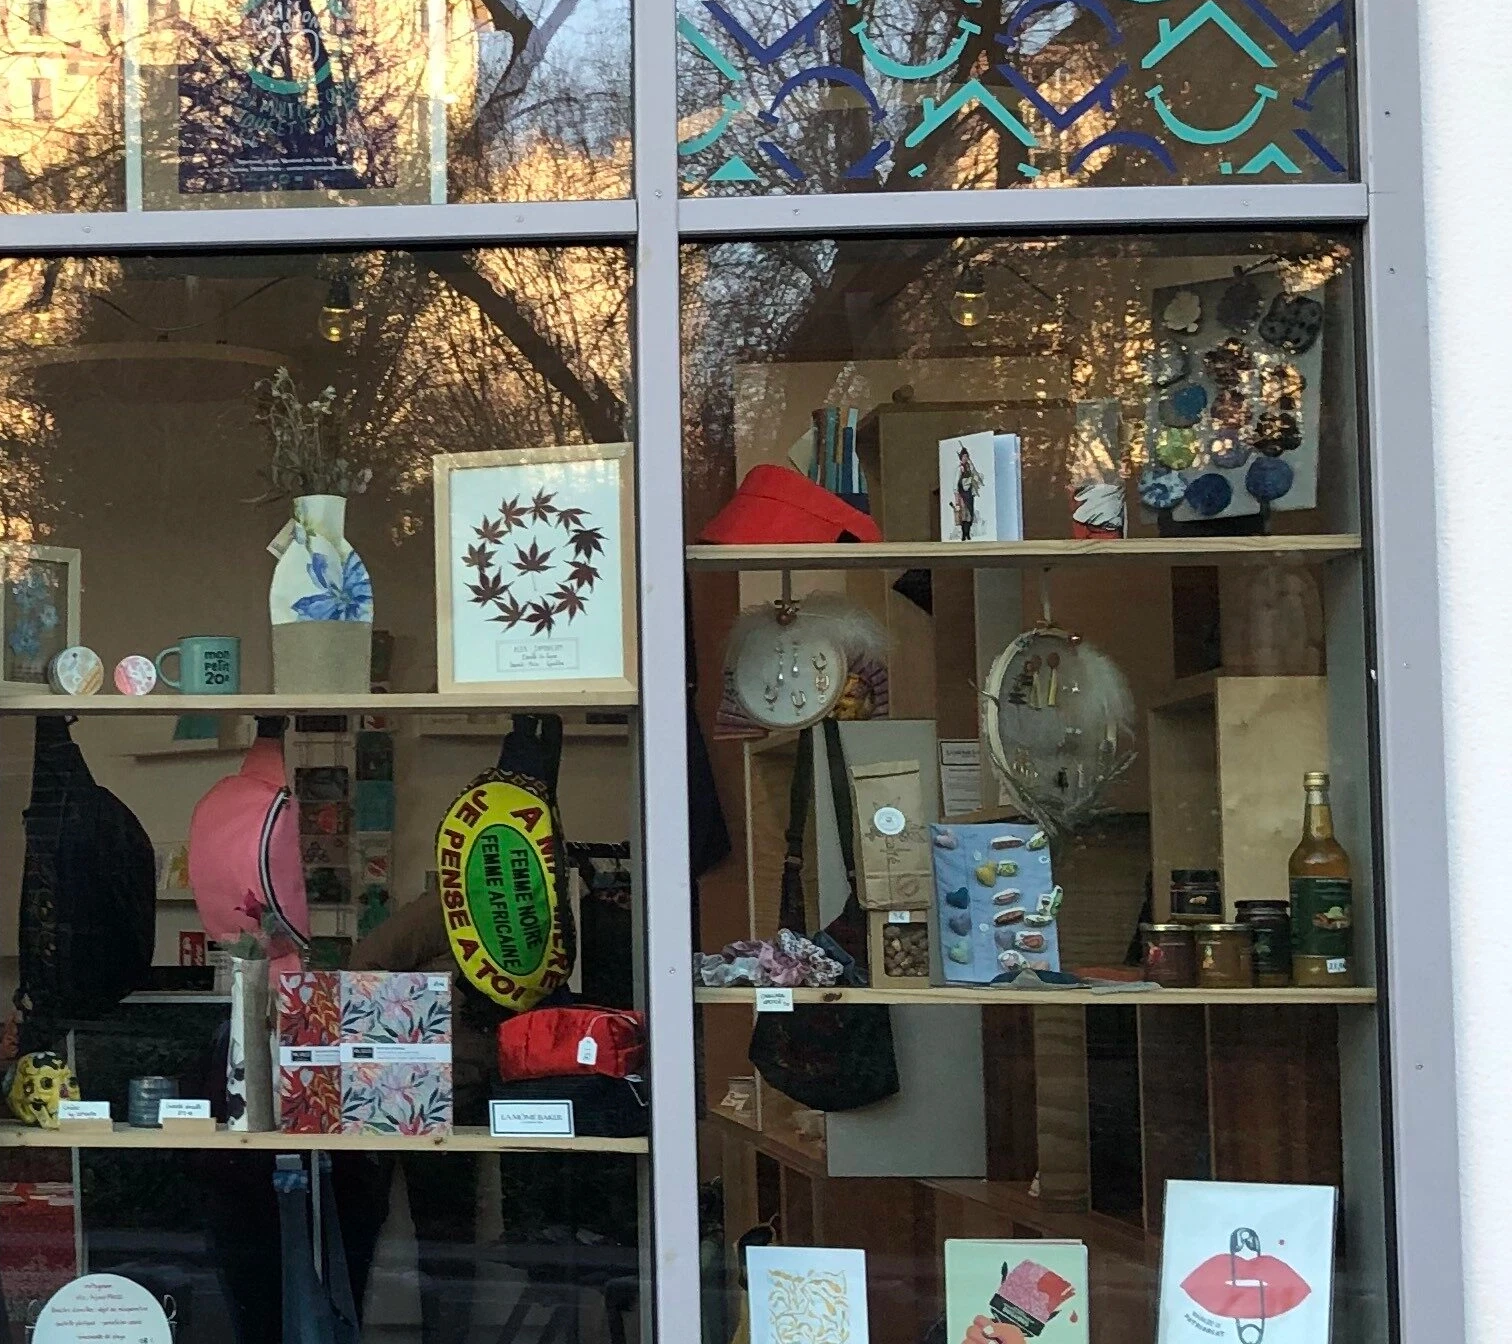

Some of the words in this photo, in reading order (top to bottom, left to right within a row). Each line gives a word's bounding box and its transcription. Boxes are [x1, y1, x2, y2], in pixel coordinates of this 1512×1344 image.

[454, 789, 489, 828] JE
[509, 806, 544, 834] A
[440, 828, 471, 930] PENSE
[480, 834, 504, 887] FEMME
[509, 848, 533, 903] FEMME
[456, 938, 480, 962] A
[488, 891, 522, 971] AFRICAINE
[517, 905, 542, 950] NOIRE
[475, 957, 527, 1001] TOI
